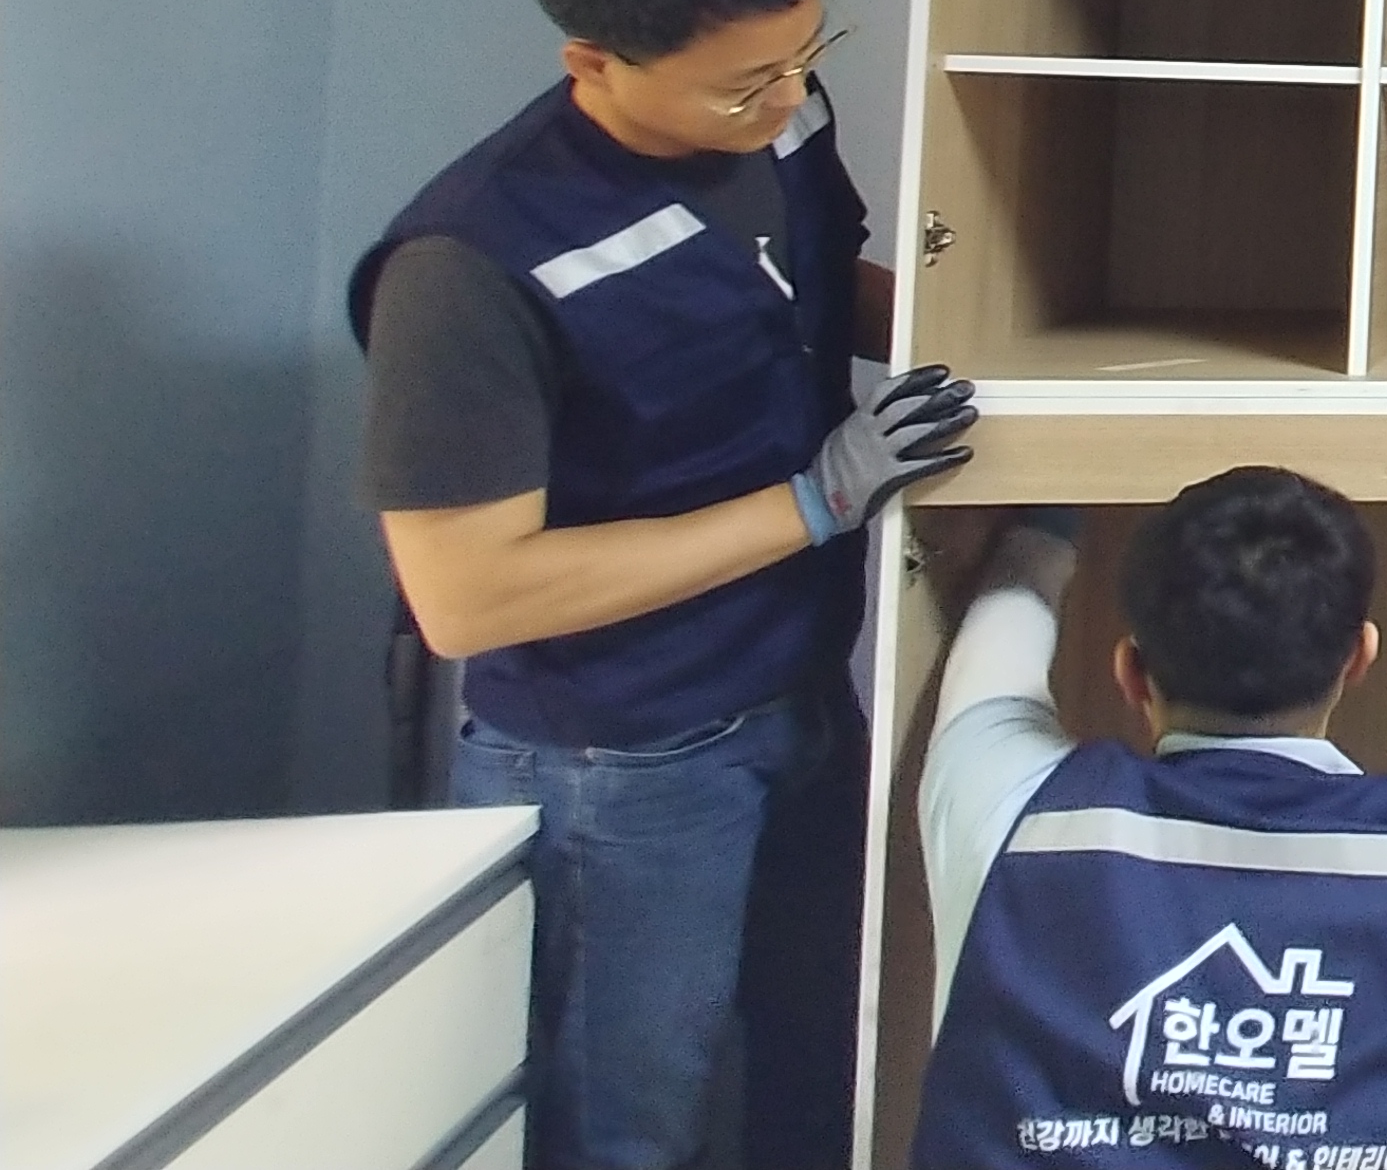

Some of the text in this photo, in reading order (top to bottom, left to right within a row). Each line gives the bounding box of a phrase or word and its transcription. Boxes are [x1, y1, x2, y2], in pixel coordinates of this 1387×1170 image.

[1163, 997, 1344, 1080] 한오멜
[1150, 1071, 1277, 1105] HOMECARE
[1207, 1104, 1328, 1135] & INTERIOR
